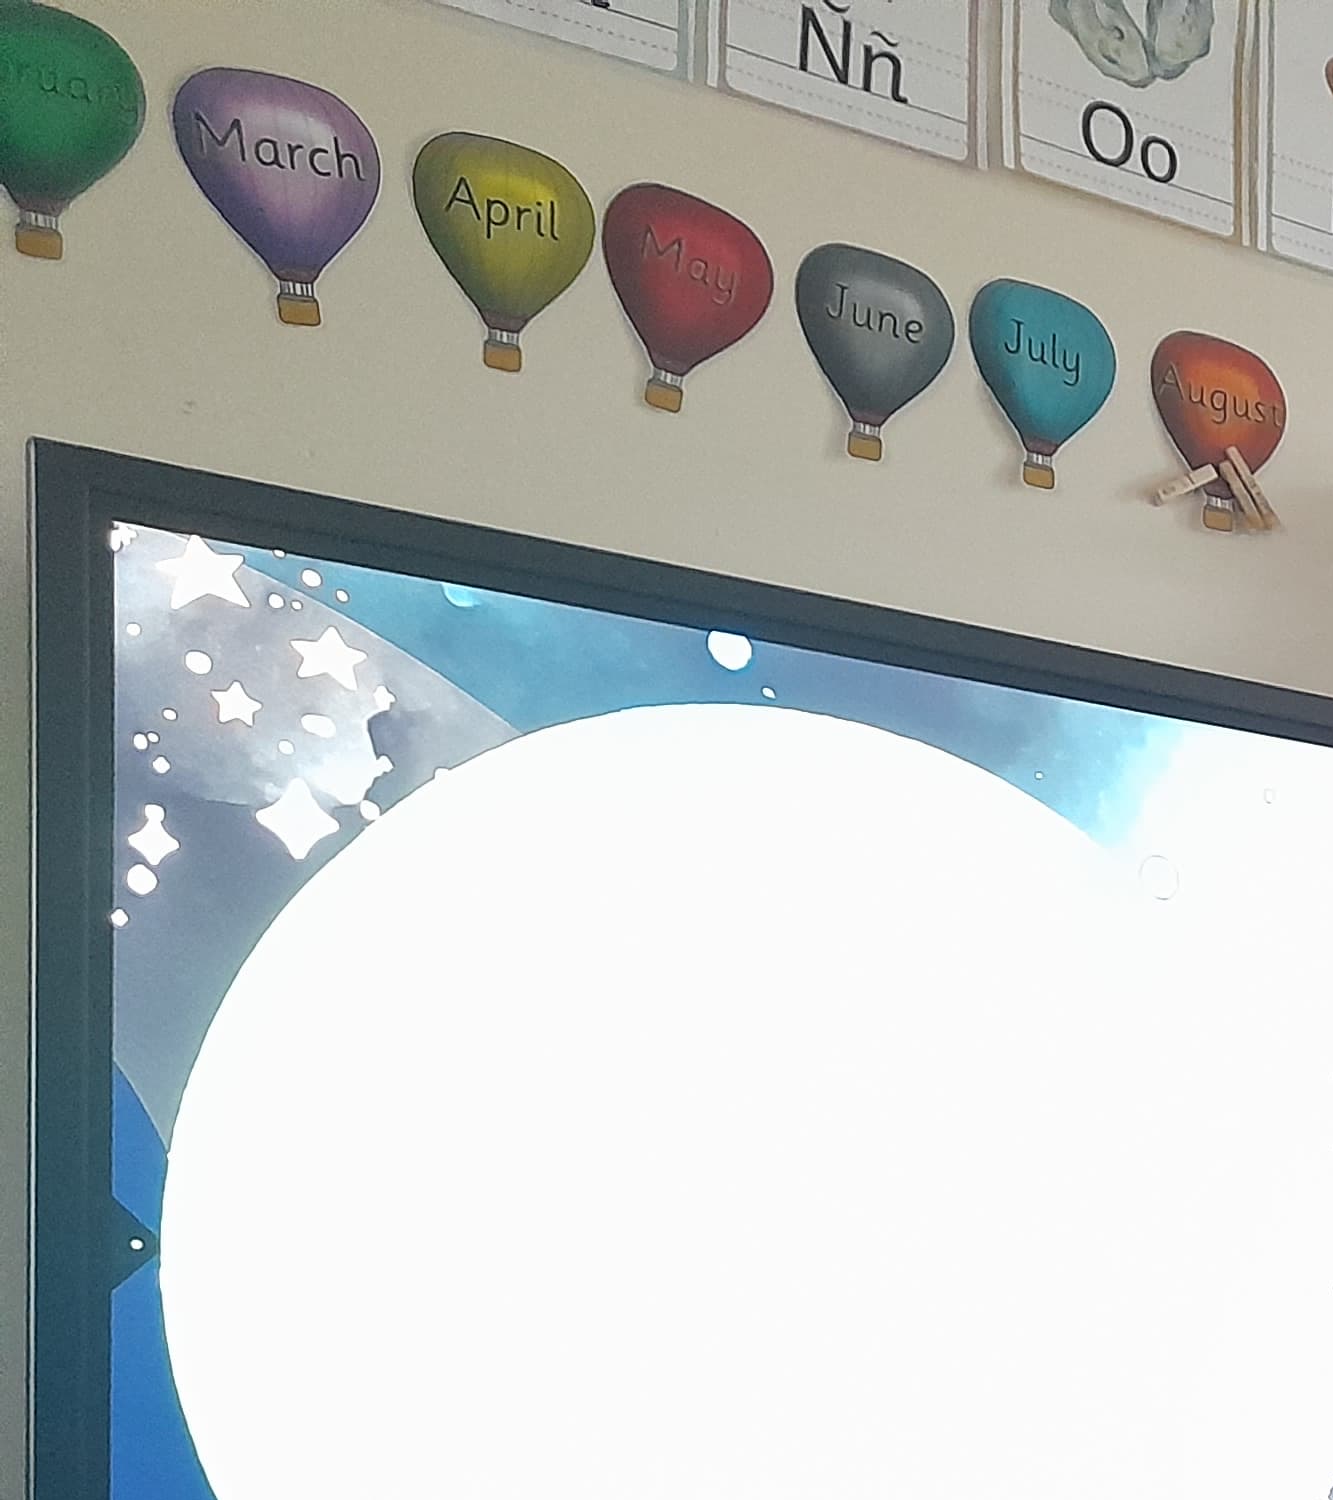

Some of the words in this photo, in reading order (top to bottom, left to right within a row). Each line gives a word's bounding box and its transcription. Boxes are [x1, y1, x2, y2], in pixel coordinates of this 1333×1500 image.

[800, 0, 907, 104] Ññ
[196, 112, 366, 181] March
[1081, 101, 1178, 184] Oo
[444, 177, 559, 240] April
[641, 226, 737, 305] May
[826, 283, 925, 345] June
[1003, 319, 1083, 386] July
[1155, 364, 1282, 428] August
